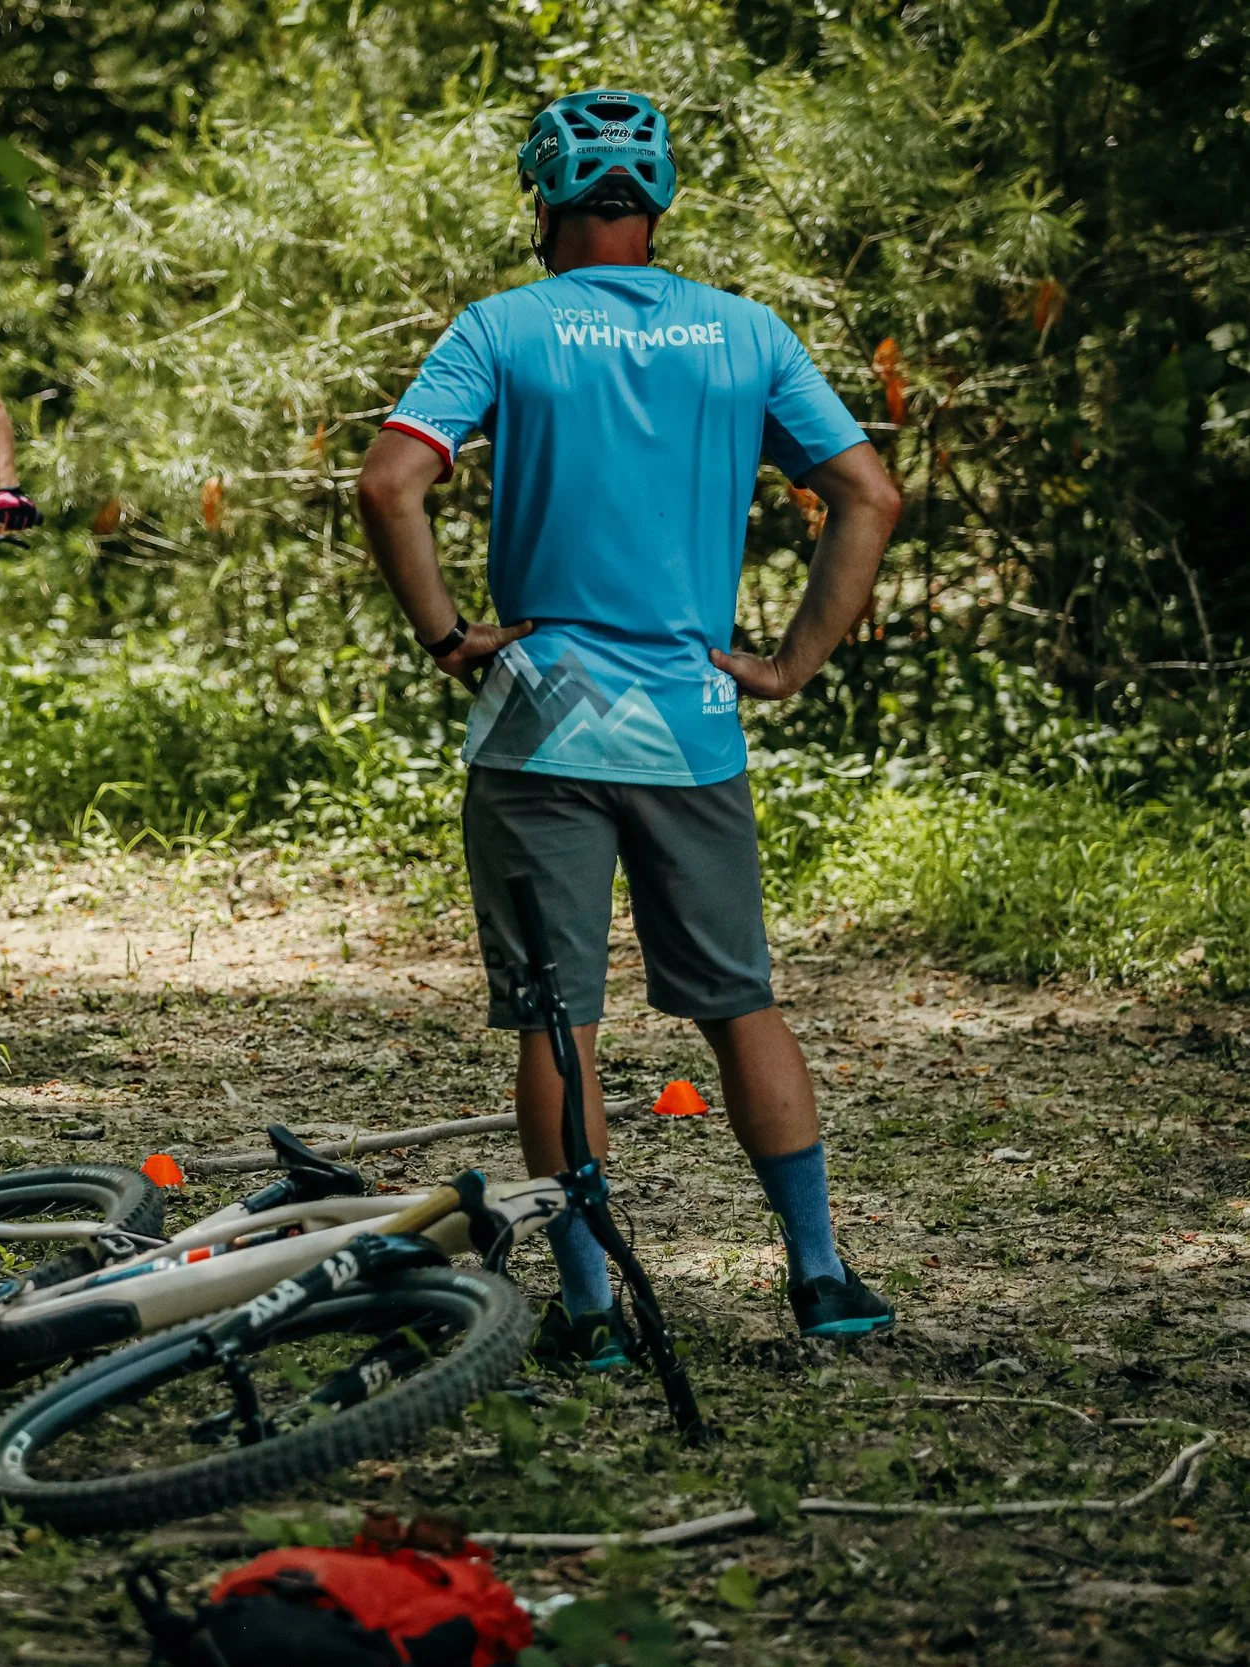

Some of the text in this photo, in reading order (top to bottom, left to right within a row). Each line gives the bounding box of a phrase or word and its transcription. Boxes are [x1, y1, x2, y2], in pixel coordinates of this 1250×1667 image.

[576, 146, 614, 155] CERTIFIED
[614, 146, 656, 157] INSTRUCTOR
[552, 308, 610, 324] JOSH
[554, 321, 726, 351] WHITMORE
[701, 704, 725, 715] SKILLS
